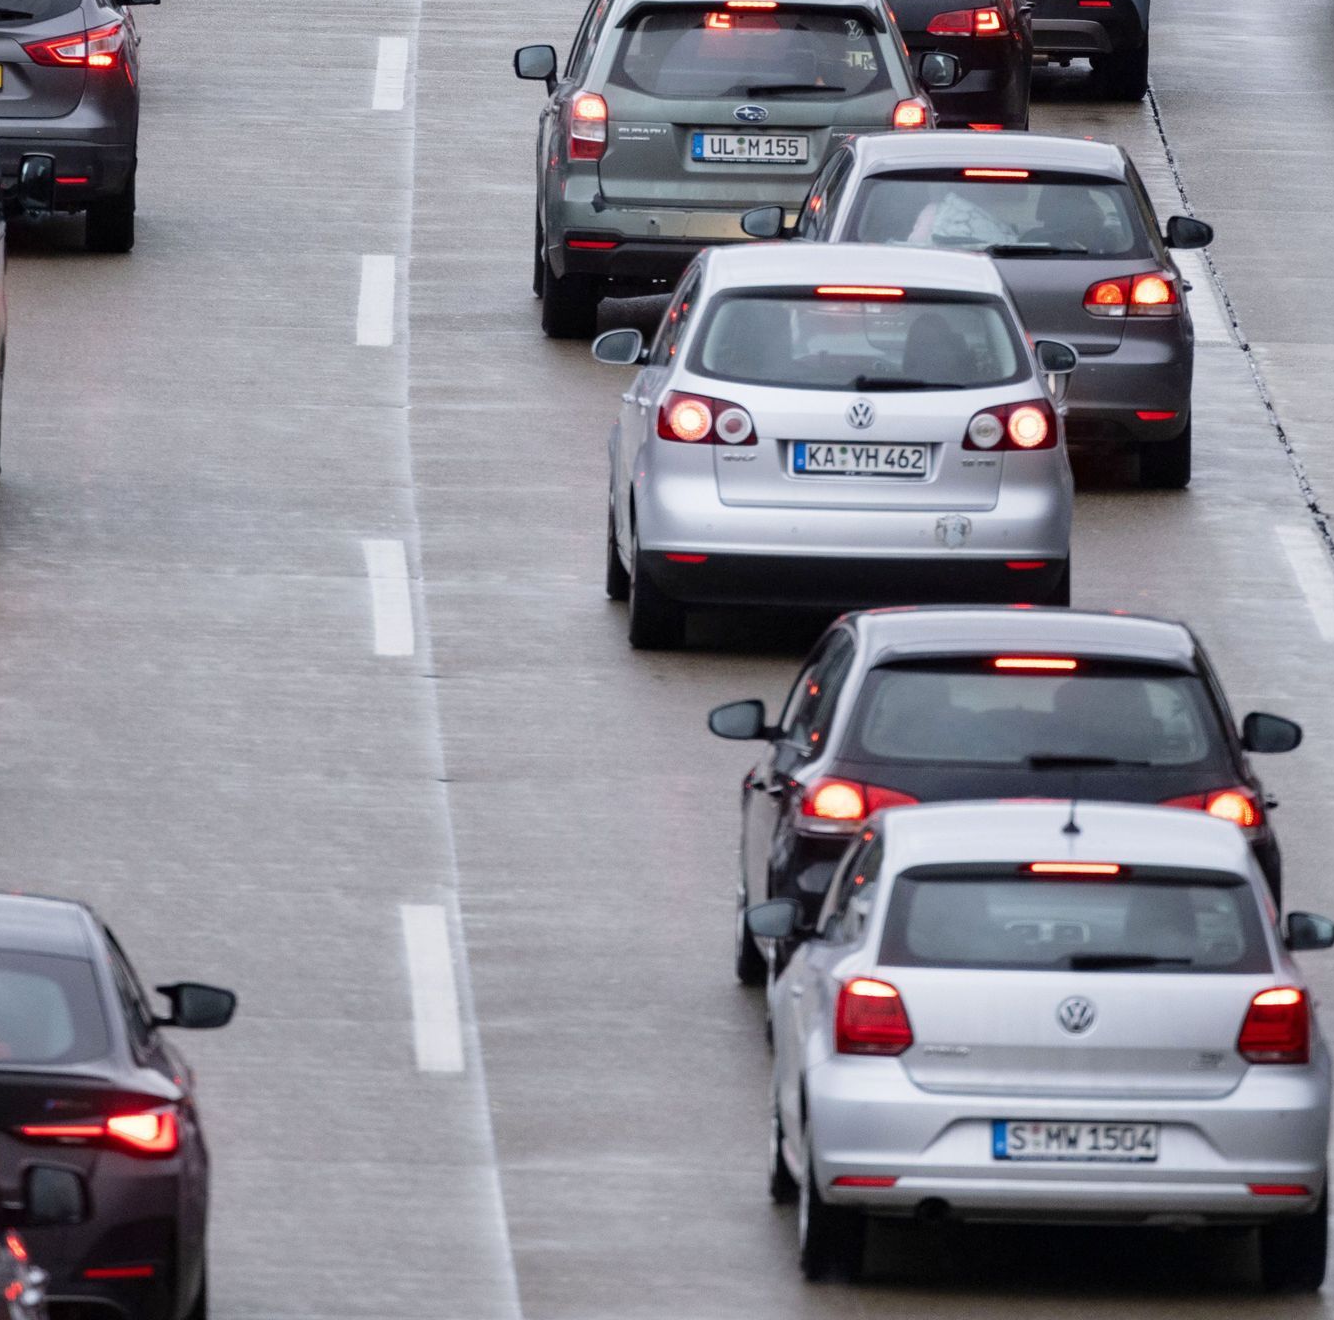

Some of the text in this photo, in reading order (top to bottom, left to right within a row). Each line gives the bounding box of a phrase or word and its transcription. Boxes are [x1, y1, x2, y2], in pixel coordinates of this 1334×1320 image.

[709, 137, 799, 157] UL M 155
[808, 446, 923, 470] KA YH 462
[1011, 1126, 1153, 1152] S MW 1504
